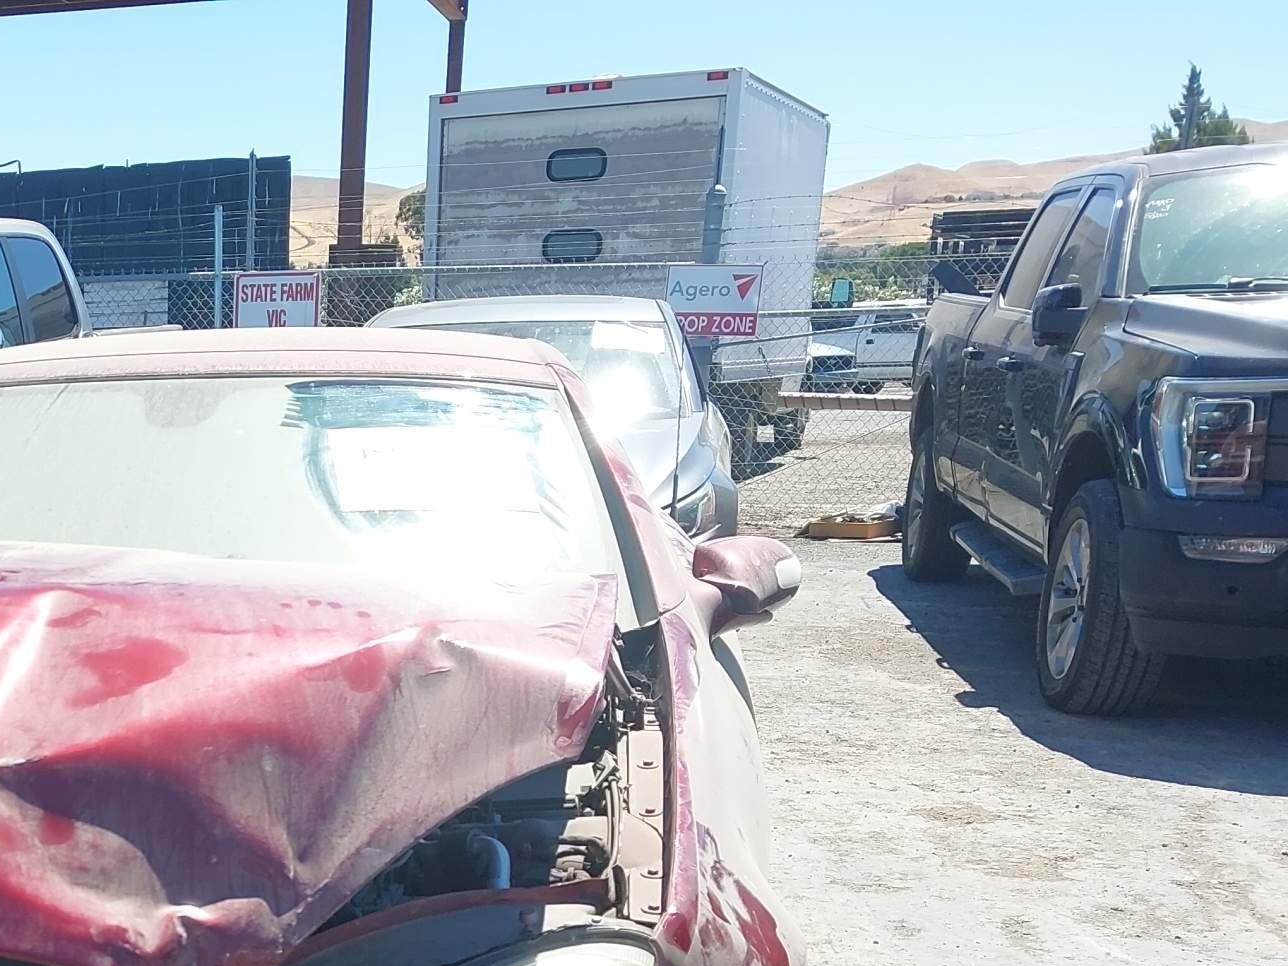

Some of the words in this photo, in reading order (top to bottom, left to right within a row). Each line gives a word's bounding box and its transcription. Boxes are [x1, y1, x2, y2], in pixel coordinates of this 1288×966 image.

[241, 284, 277, 302] STATE
[280, 283, 314, 301] FARM
[669, 281, 730, 301] Agero
[267, 309, 287, 327] VIC
[712, 316, 754, 333] ZONE
